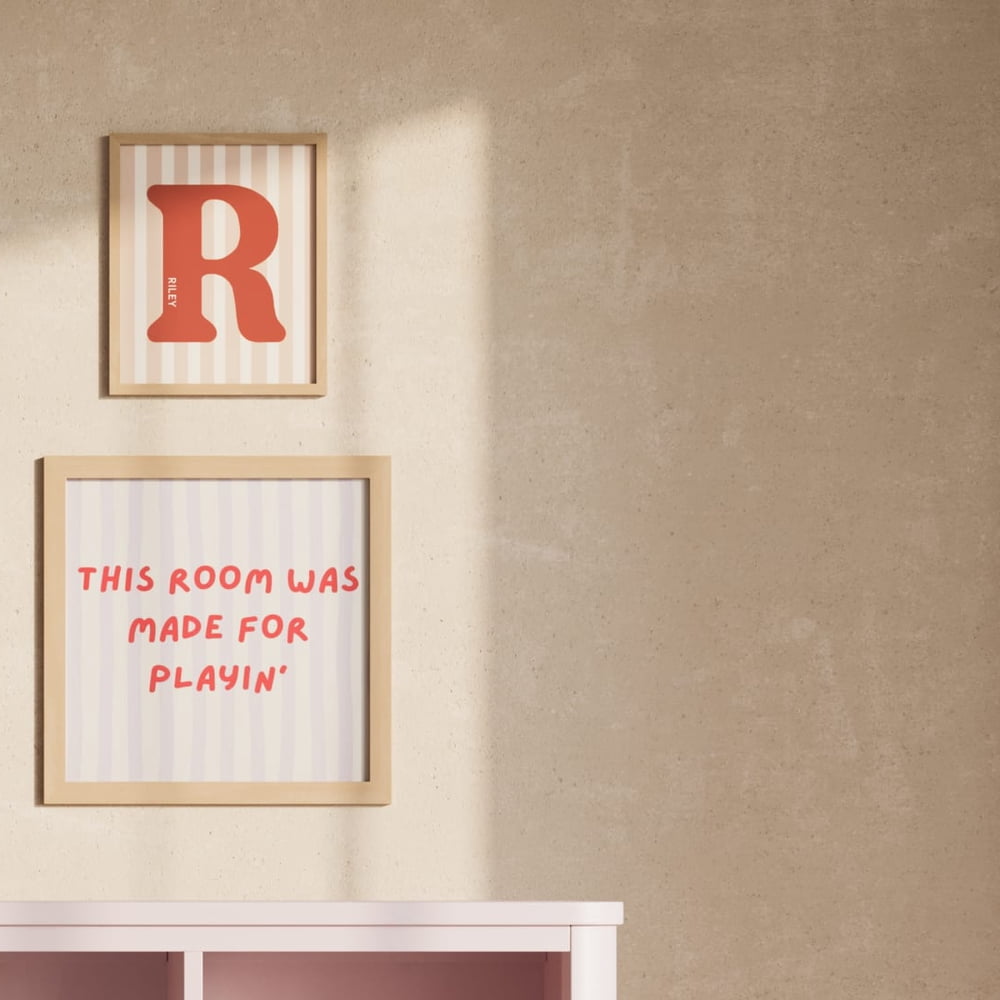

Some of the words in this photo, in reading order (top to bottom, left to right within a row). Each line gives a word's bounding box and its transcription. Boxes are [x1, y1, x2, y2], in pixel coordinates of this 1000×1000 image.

[147, 184, 286, 343] R
[167, 277, 177, 308] RILEY
[78, 565, 154, 593] THIS
[168, 565, 273, 595] ROOM
[287, 565, 359, 594] WAS
[128, 614, 223, 643] MADE
[238, 614, 309, 644] FOR
[149, 664, 288, 693] PLAYIN'
